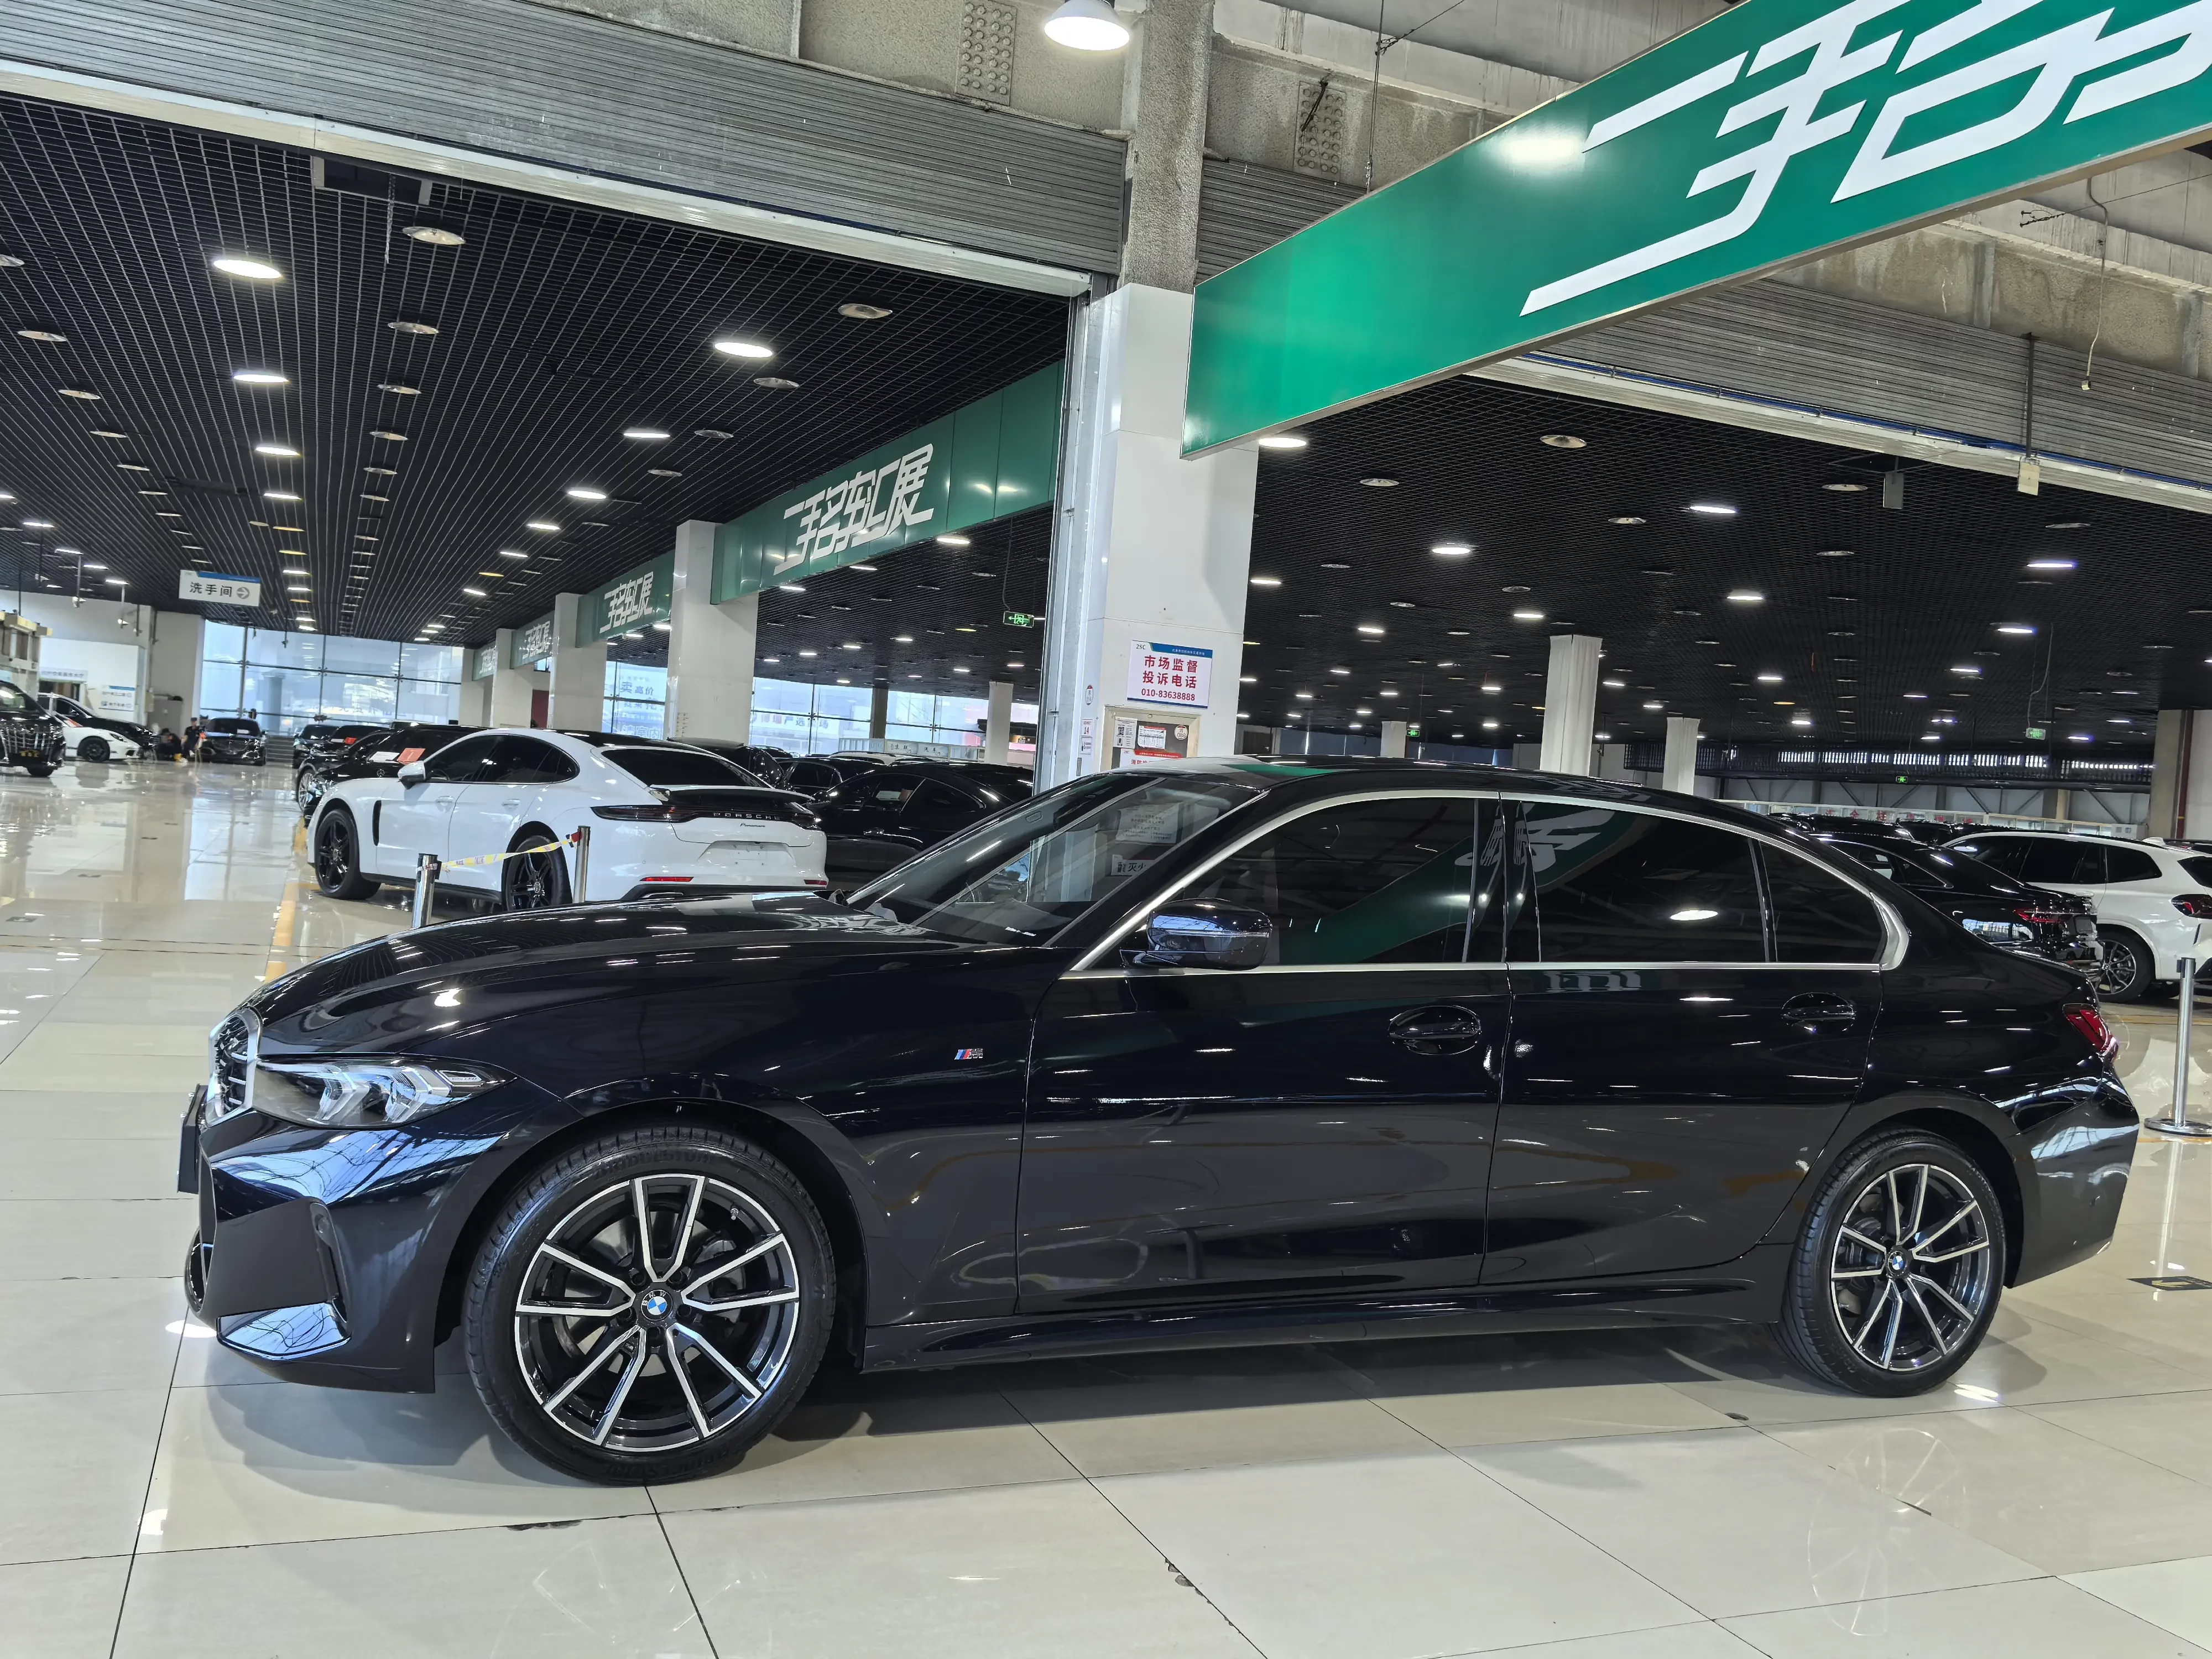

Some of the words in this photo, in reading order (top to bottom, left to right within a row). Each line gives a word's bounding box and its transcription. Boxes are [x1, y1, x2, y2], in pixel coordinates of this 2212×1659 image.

[189, 581, 232, 597] 洗手间
[1144, 655, 1198, 674] 市场监督
[1142, 670, 1197, 689] 投诉电话
[1141, 688, 1196, 701] 010-83638888
[713, 812, 781, 821] PORSCHE
[641, 1291, 667, 1307] BMW
